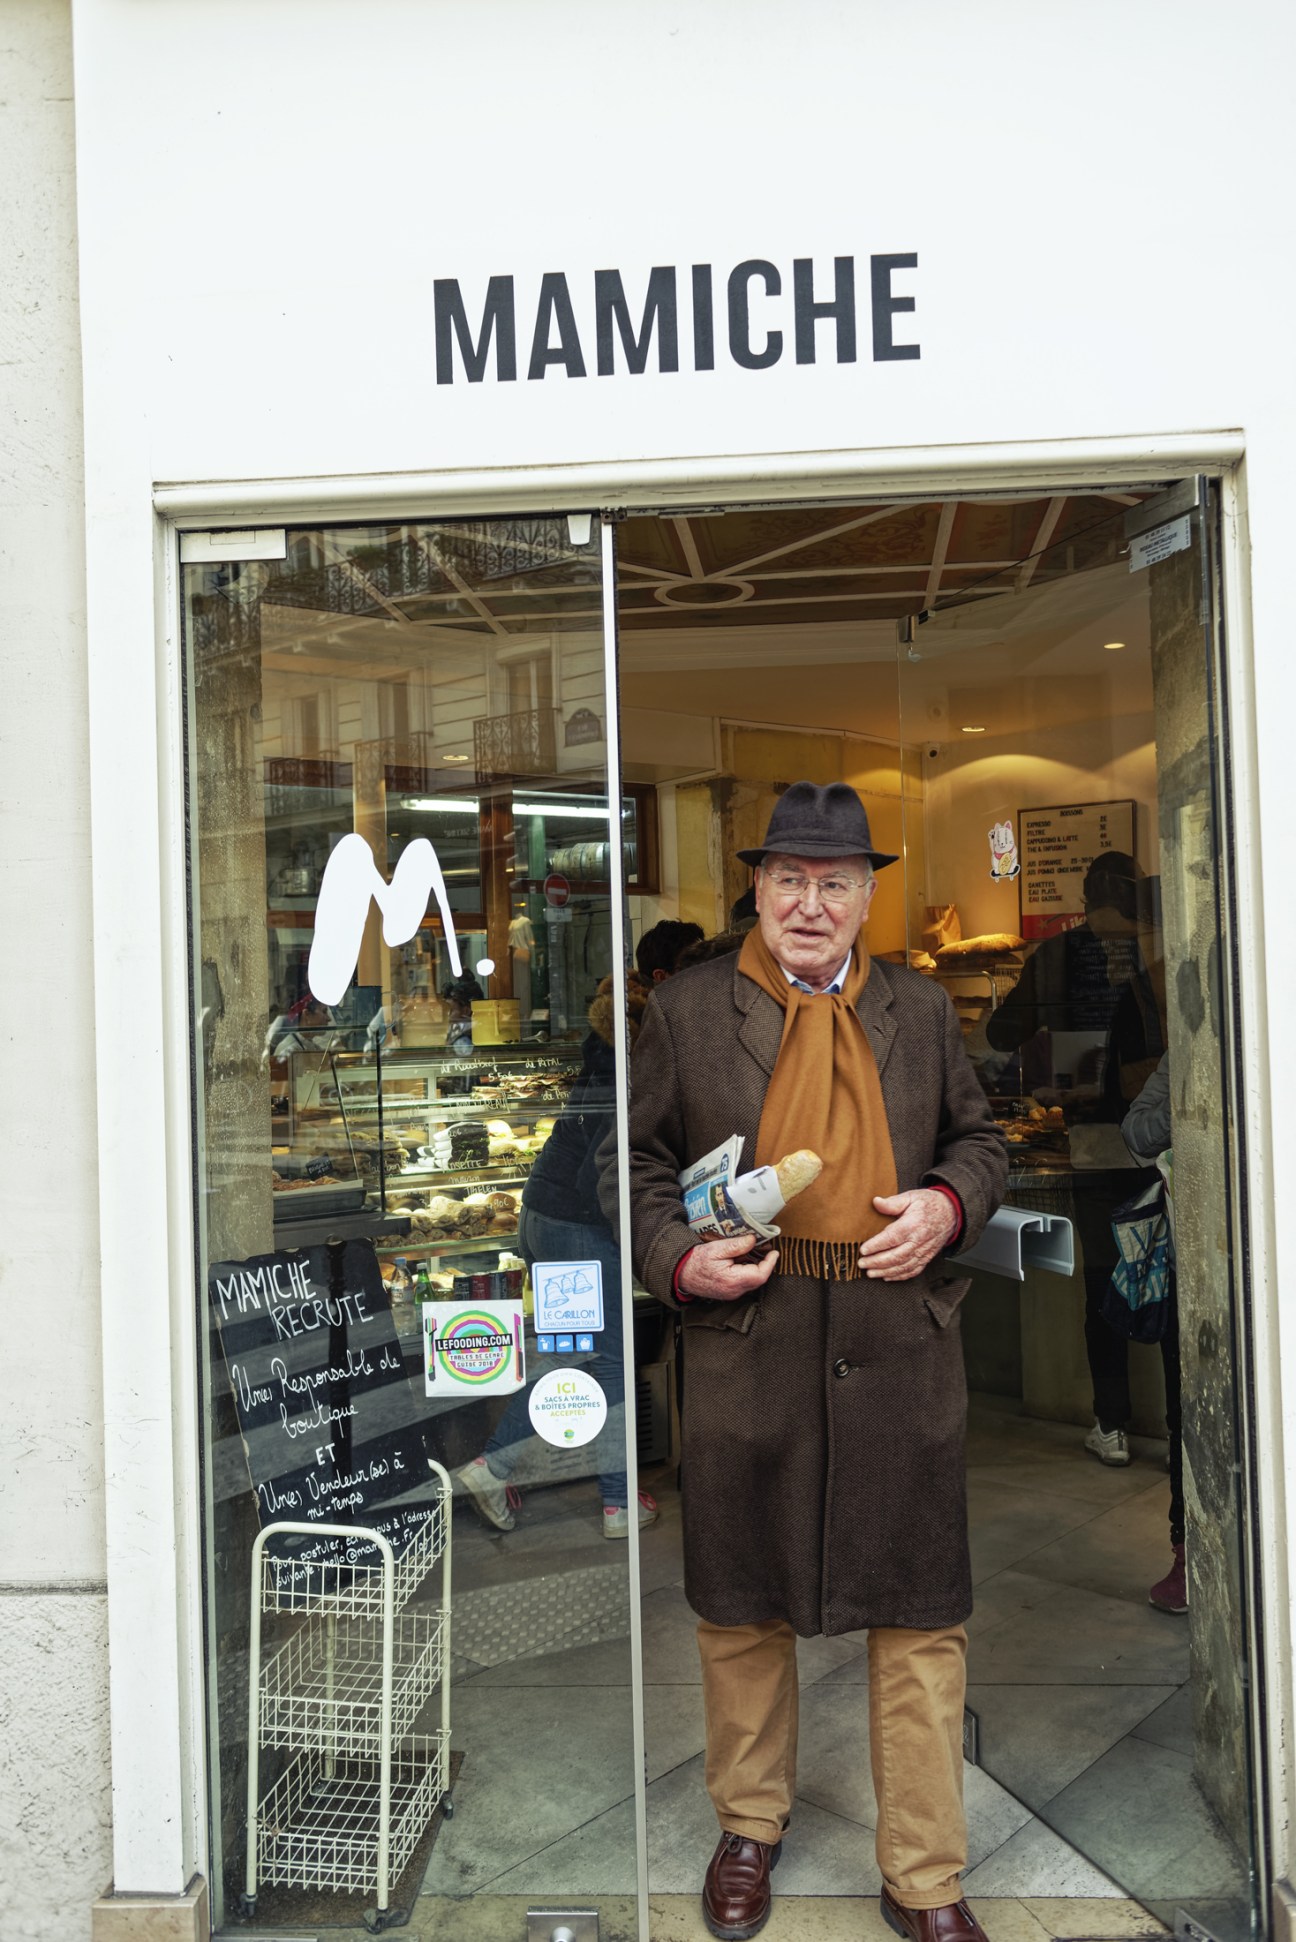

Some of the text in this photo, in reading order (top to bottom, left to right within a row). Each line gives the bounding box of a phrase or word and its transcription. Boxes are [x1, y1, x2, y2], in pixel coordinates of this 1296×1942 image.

[433, 252, 921, 385] MAMICHE
[216, 1259, 317, 1320] MAMICHE
[271, 1293, 374, 1341] RECRUTE
[544, 1309, 595, 1320] LE CARILLON
[437, 1335, 511, 1350] LEFOODING.COM
[271, 1349, 374, 1414] Responsable
[379, 1347, 401, 1370] de
[557, 1382, 576, 1394] ICI
[544, 1395, 563, 1403] SACS
[569, 1394, 590, 1402] VRAC
[567, 1401, 601, 1409] PROPRES
[279, 1400, 359, 1439] boutique
[315, 1442, 336, 1466] ET
[305, 1458, 390, 1501] Vendeur(se)
[307, 1490, 364, 1521] mi-temps
